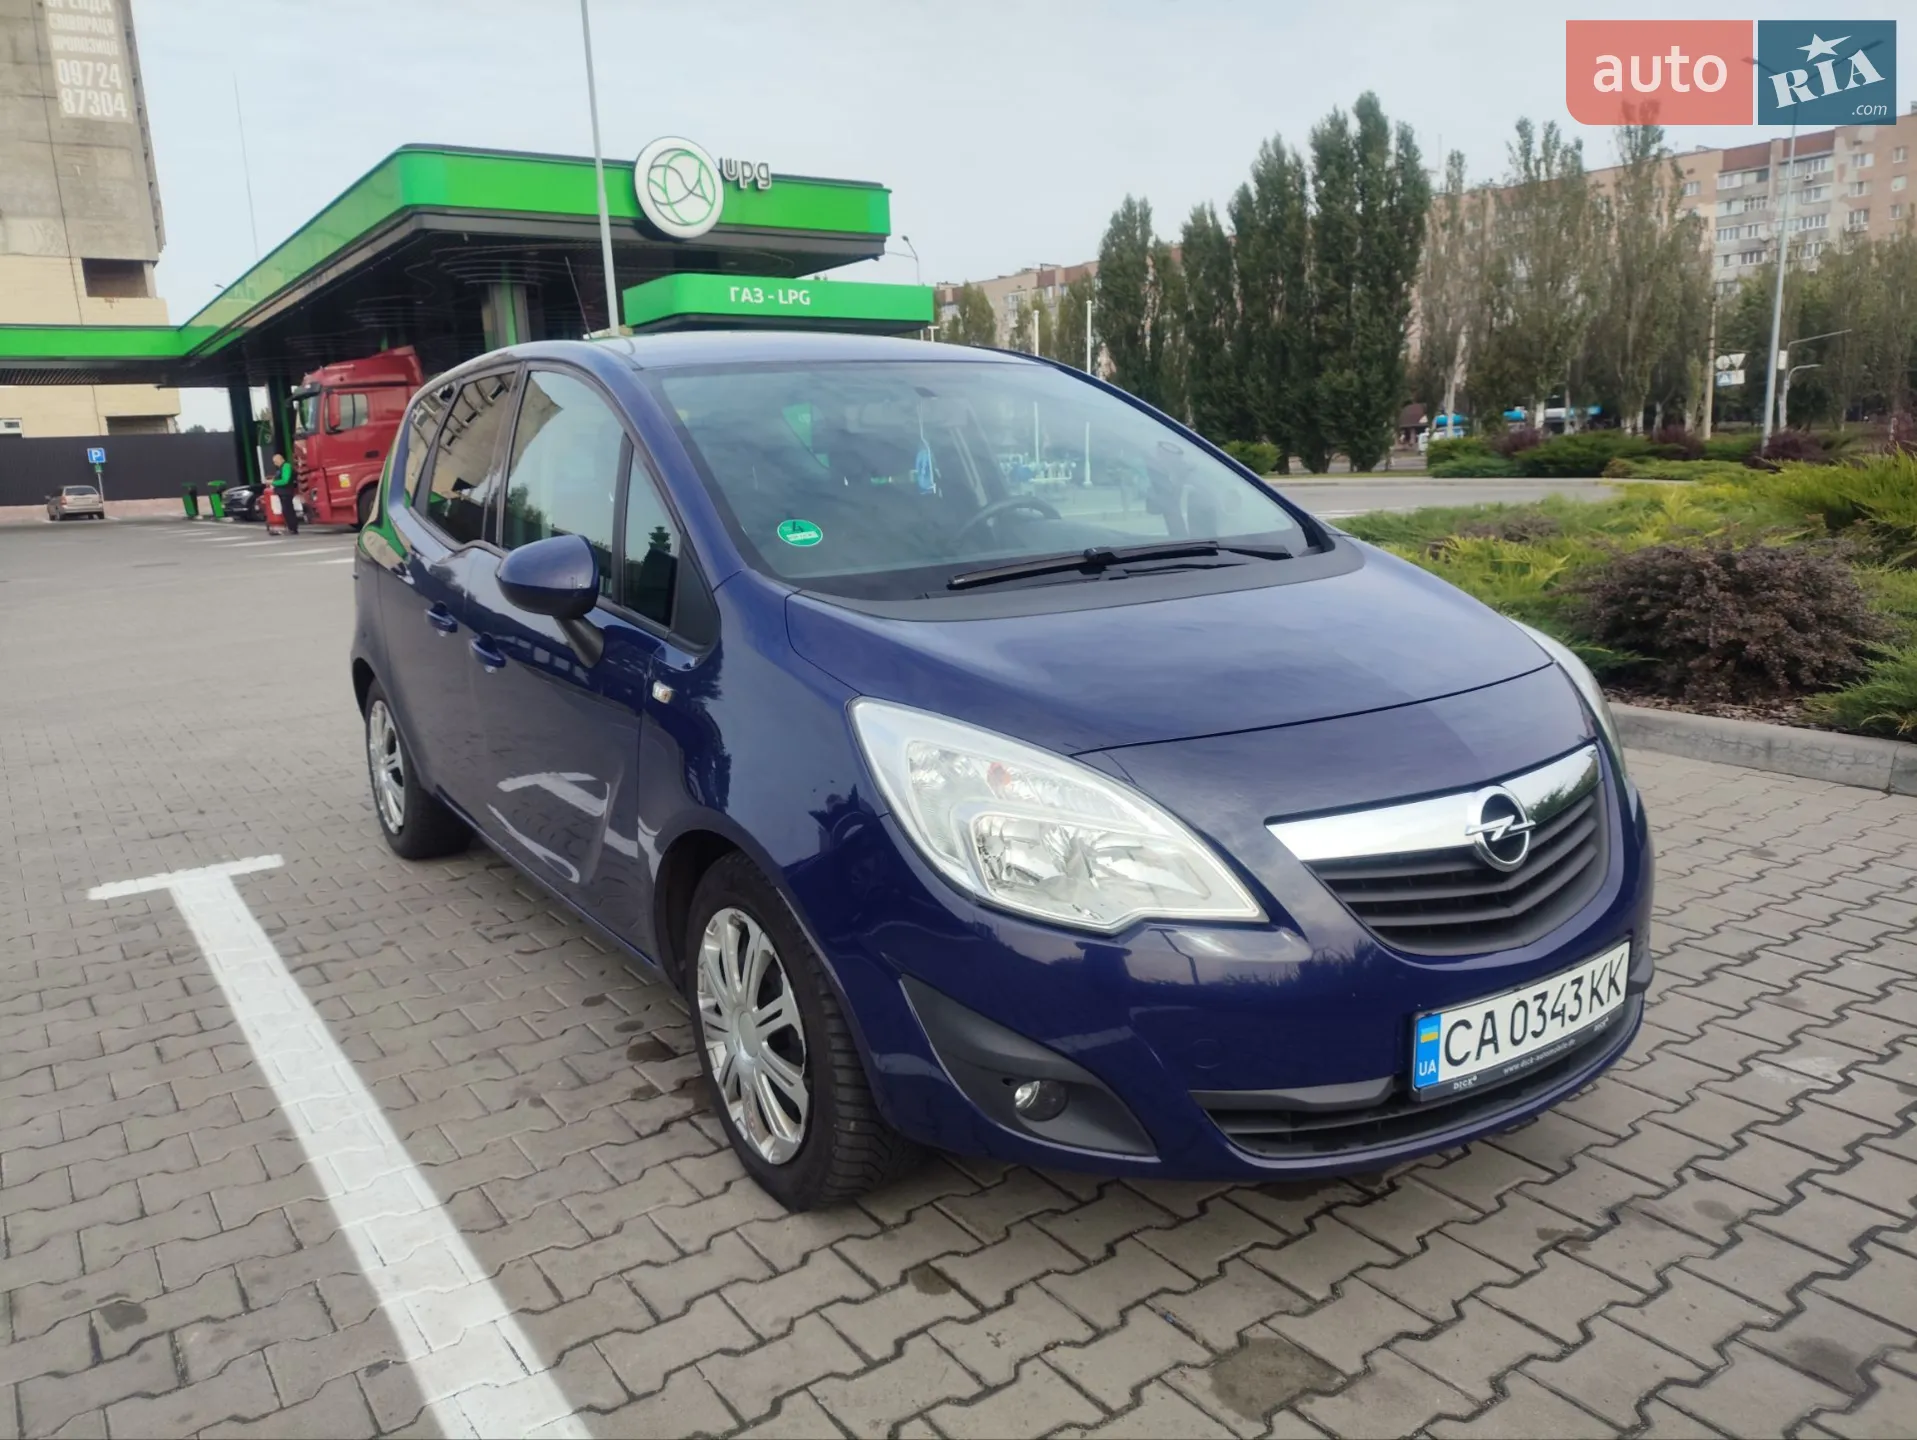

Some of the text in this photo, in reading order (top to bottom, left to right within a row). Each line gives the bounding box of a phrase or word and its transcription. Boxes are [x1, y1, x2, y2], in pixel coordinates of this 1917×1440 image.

[58, 59, 122, 89] 09724
[61, 88, 127, 117] 87304
[719, 157, 772, 190] upg
[729, 286, 765, 303] ГАЗ
[777, 289, 812, 306] LPG
[1418, 1060, 1437, 1076] UA
